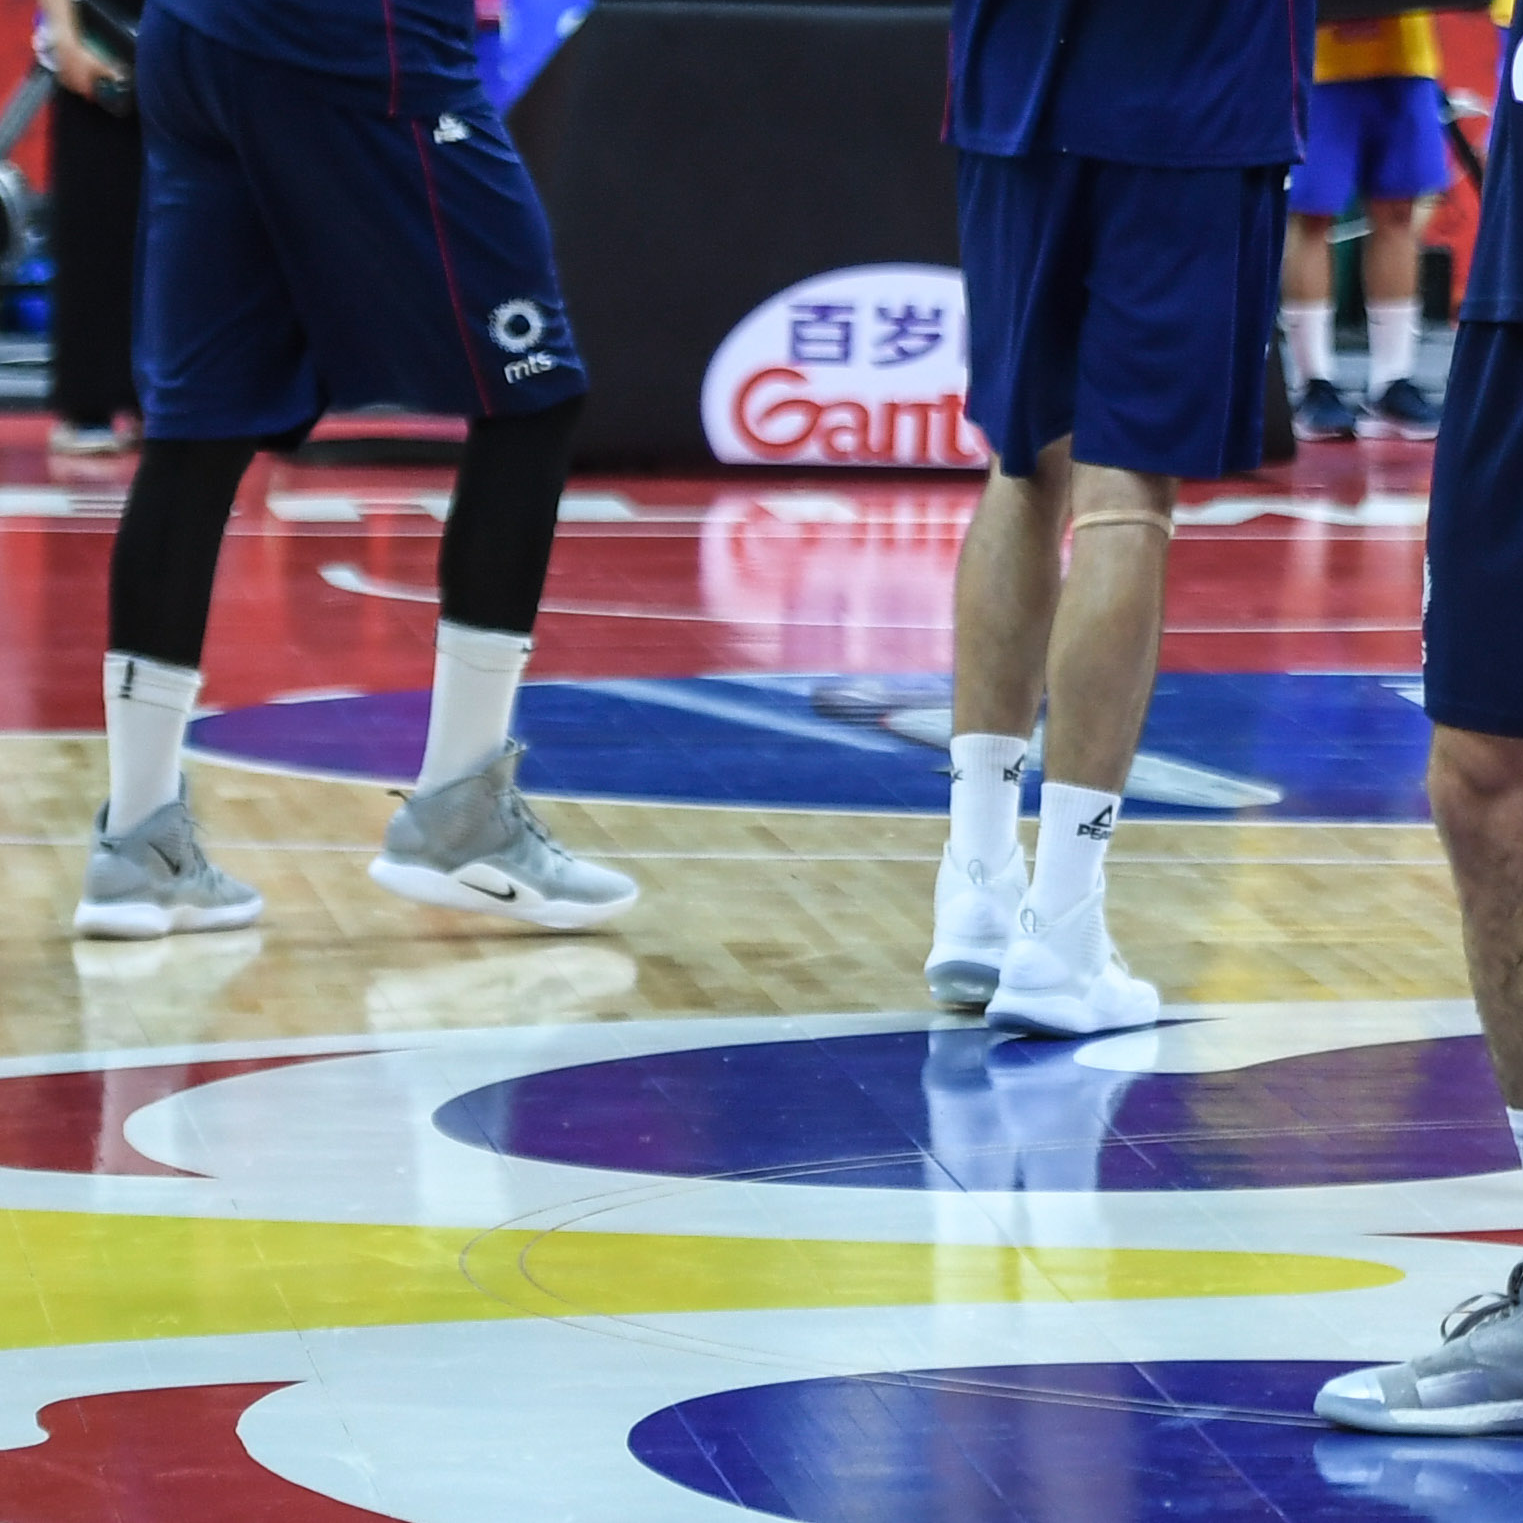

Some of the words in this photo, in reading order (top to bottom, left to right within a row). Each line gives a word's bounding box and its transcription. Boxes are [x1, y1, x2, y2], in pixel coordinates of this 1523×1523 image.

[789, 304, 966, 367] 百岁
[504, 351, 557, 385] mts
[732, 366, 988, 464] Gant
